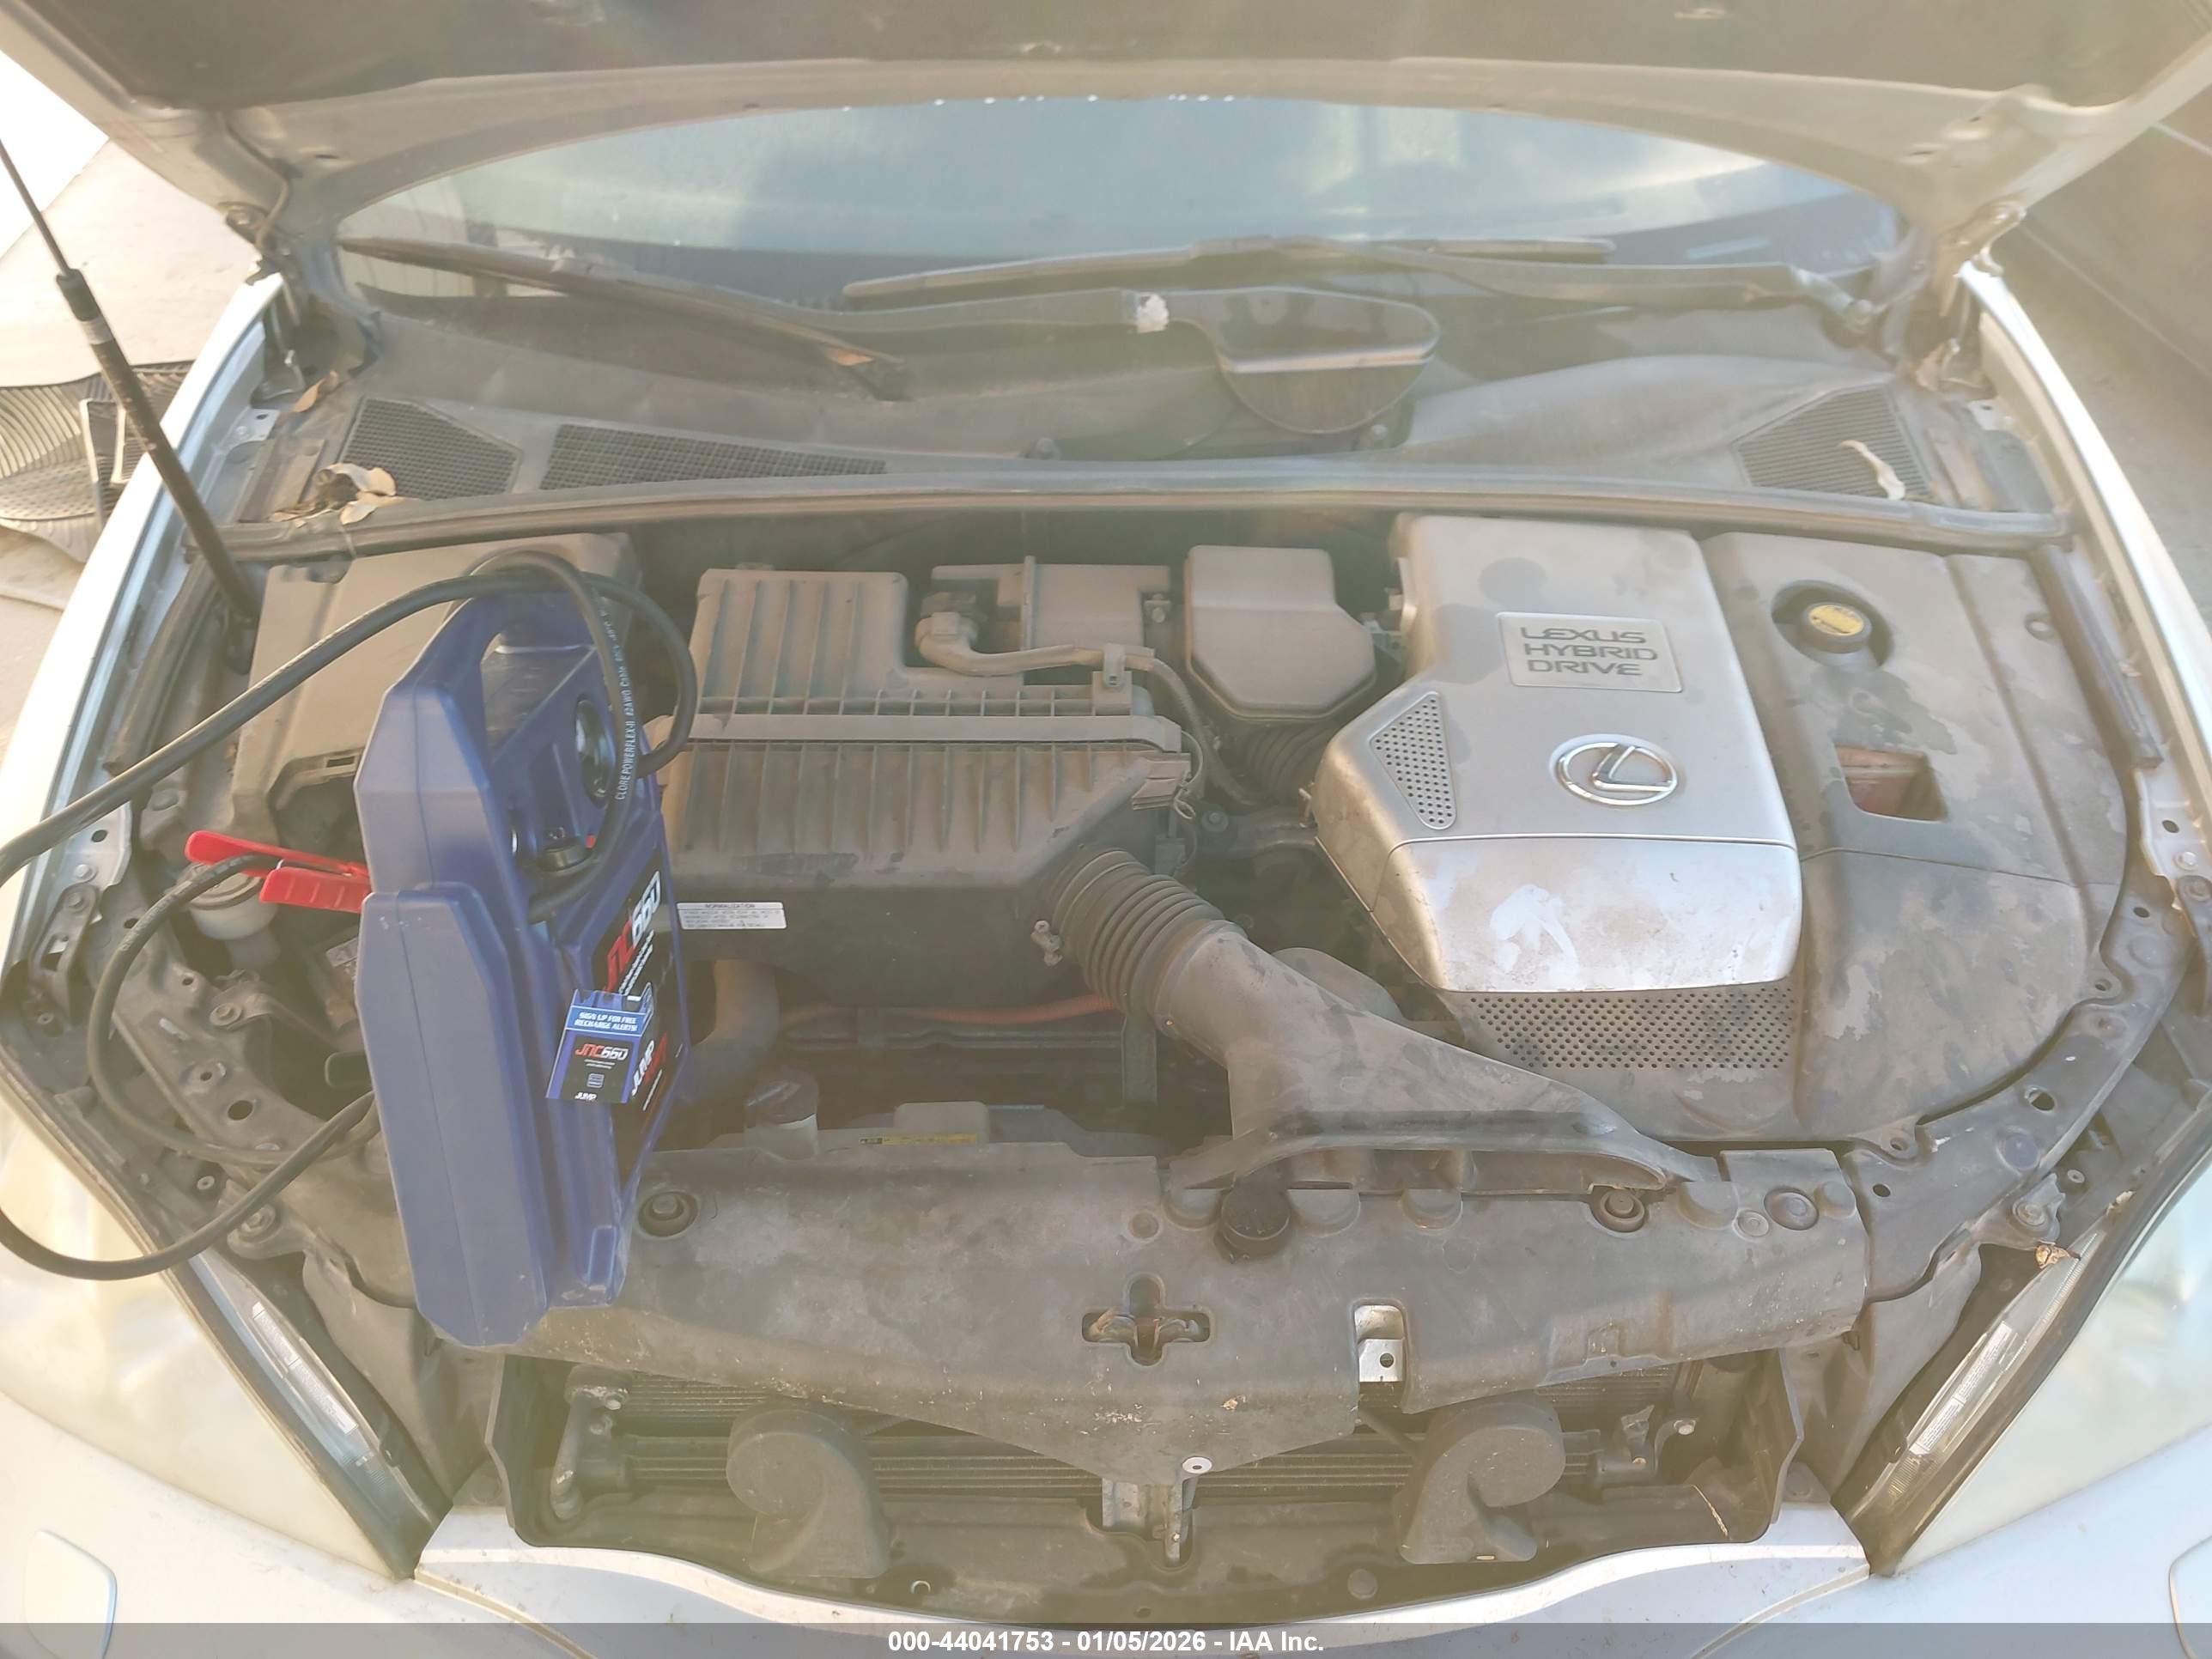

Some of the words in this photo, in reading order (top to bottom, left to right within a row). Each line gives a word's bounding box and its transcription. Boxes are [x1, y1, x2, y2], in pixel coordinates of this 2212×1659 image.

[1520, 627, 1646, 644] LEXUS
[1523, 643, 1658, 660] HYBRID
[1527, 659, 1643, 677] DRIVE
[574, 1043, 629, 1060] JNC660
